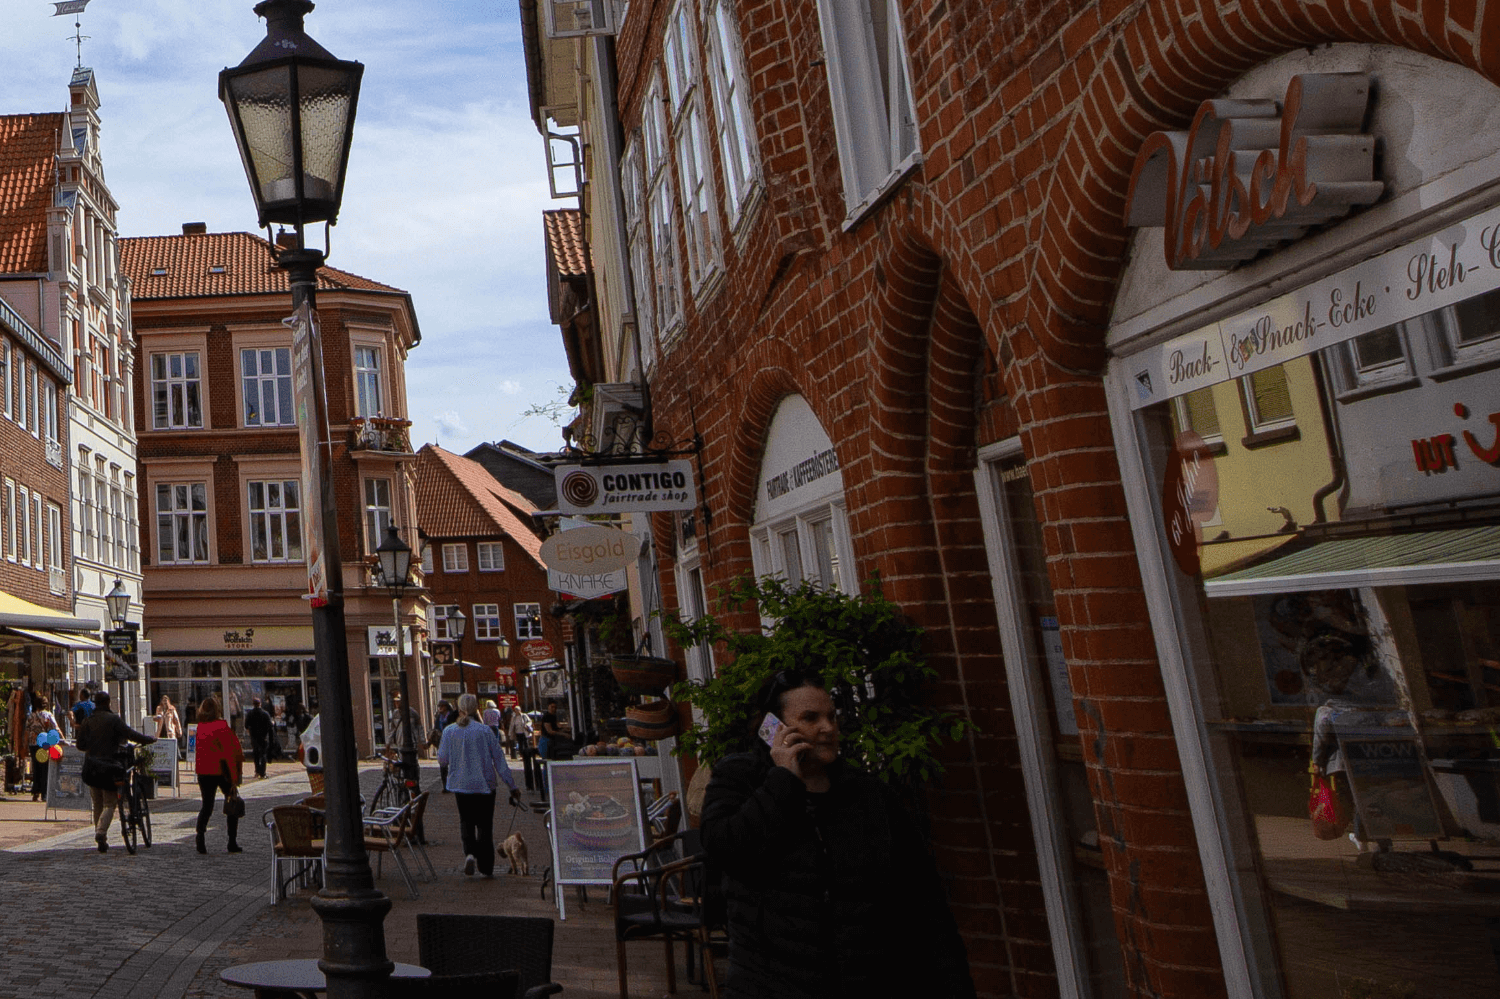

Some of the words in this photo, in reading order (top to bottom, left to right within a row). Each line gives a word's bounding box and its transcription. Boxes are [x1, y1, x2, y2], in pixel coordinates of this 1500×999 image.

[1169, 340, 1220, 384] Back-
[1253, 280, 1378, 355] Snack-Ecke
[602, 471, 686, 492] CONTIGO
[602, 492, 658, 506] fairtrade
[661, 490, 688, 503] shop
[556, 538, 624, 564] Eisgold
[223, 635, 253, 644] Wolfskin
[225, 630, 240, 639] Jack
[565, 854, 597, 864] Original
